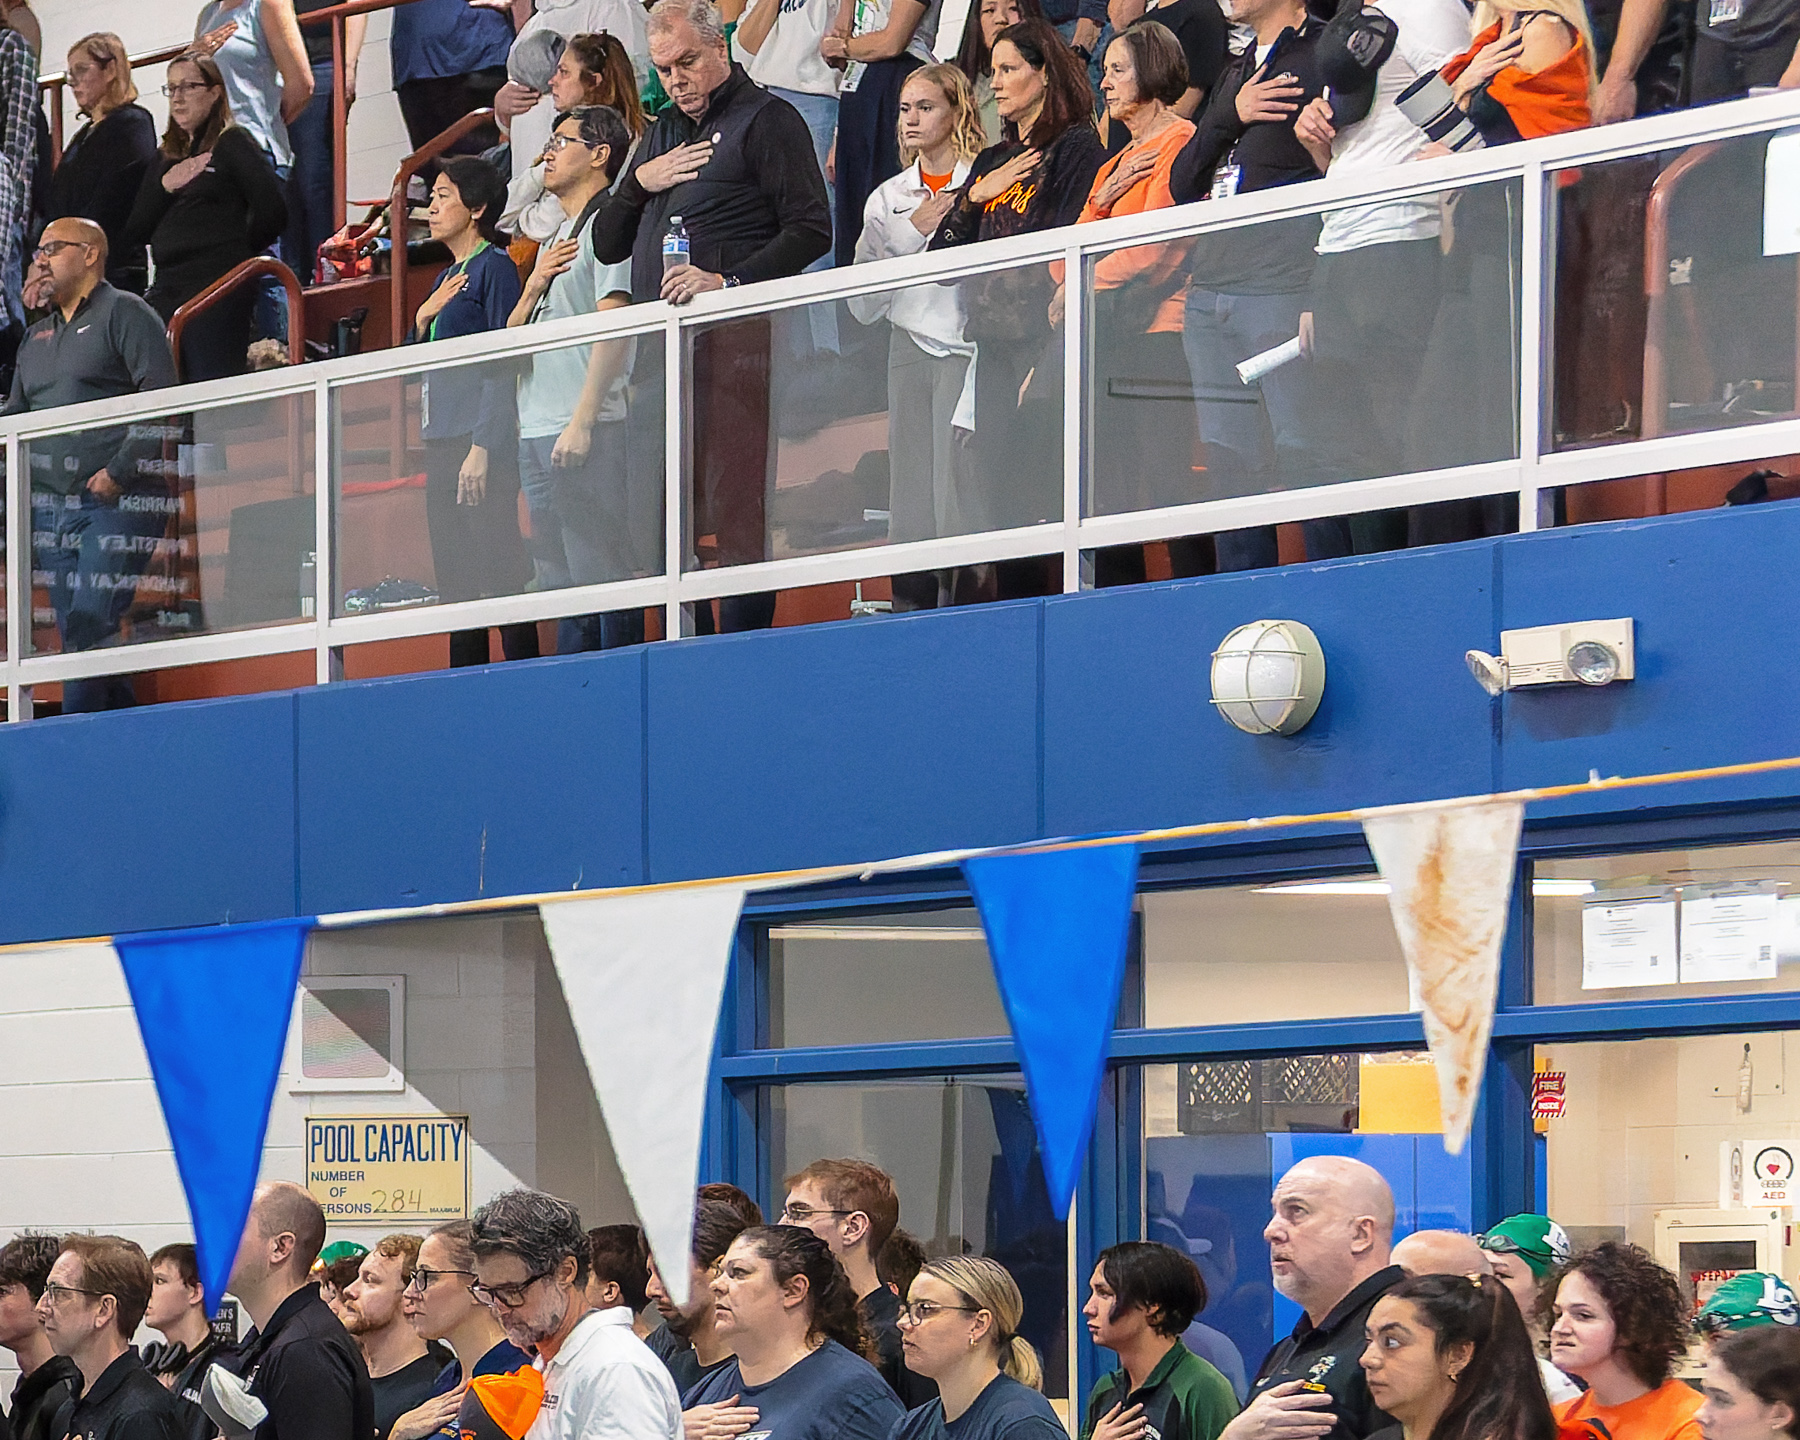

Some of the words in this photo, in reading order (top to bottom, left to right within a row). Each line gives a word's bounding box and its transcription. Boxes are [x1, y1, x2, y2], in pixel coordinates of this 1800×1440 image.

[311, 1124, 360, 1163] POOL
[365, 1122, 464, 1163] CAPACITY
[311, 1170, 365, 1182] NUMBER
[329, 1186, 347, 1198] OF
[1761, 1191, 1786, 1200] AED
[371, 1188, 424, 1213] 284
[320, 1203, 372, 1214] ERSONS
